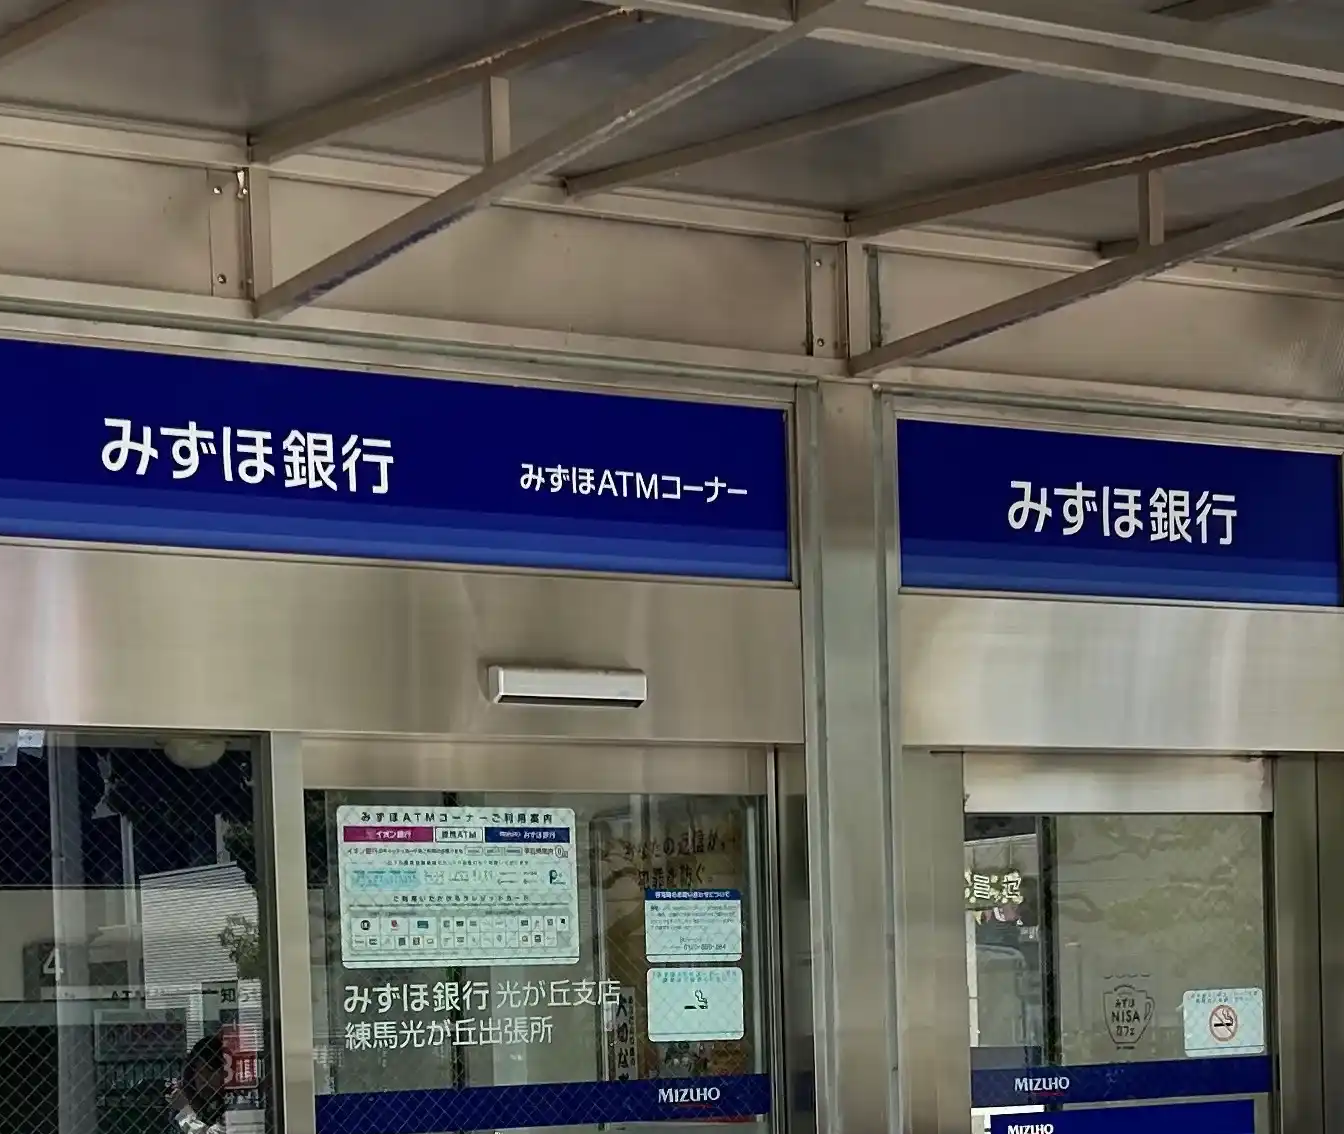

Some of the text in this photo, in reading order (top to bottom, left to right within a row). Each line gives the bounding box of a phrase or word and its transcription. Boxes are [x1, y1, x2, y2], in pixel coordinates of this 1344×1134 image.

[101, 417, 394, 495] みずほ銀行
[519, 463, 748, 503] みずほATMコーナー
[1008, 480, 1238, 546] みずほ銀行
[343, 977, 622, 1013] みずほ銀行 光が丘支店
[344, 1015, 554, 1051] 練馬光が丘出張所
[1111, 1010, 1140, 1024] NISA
[658, 1086, 721, 1104] MIZUHO
[1014, 1076, 1070, 1092] MIZUHO
